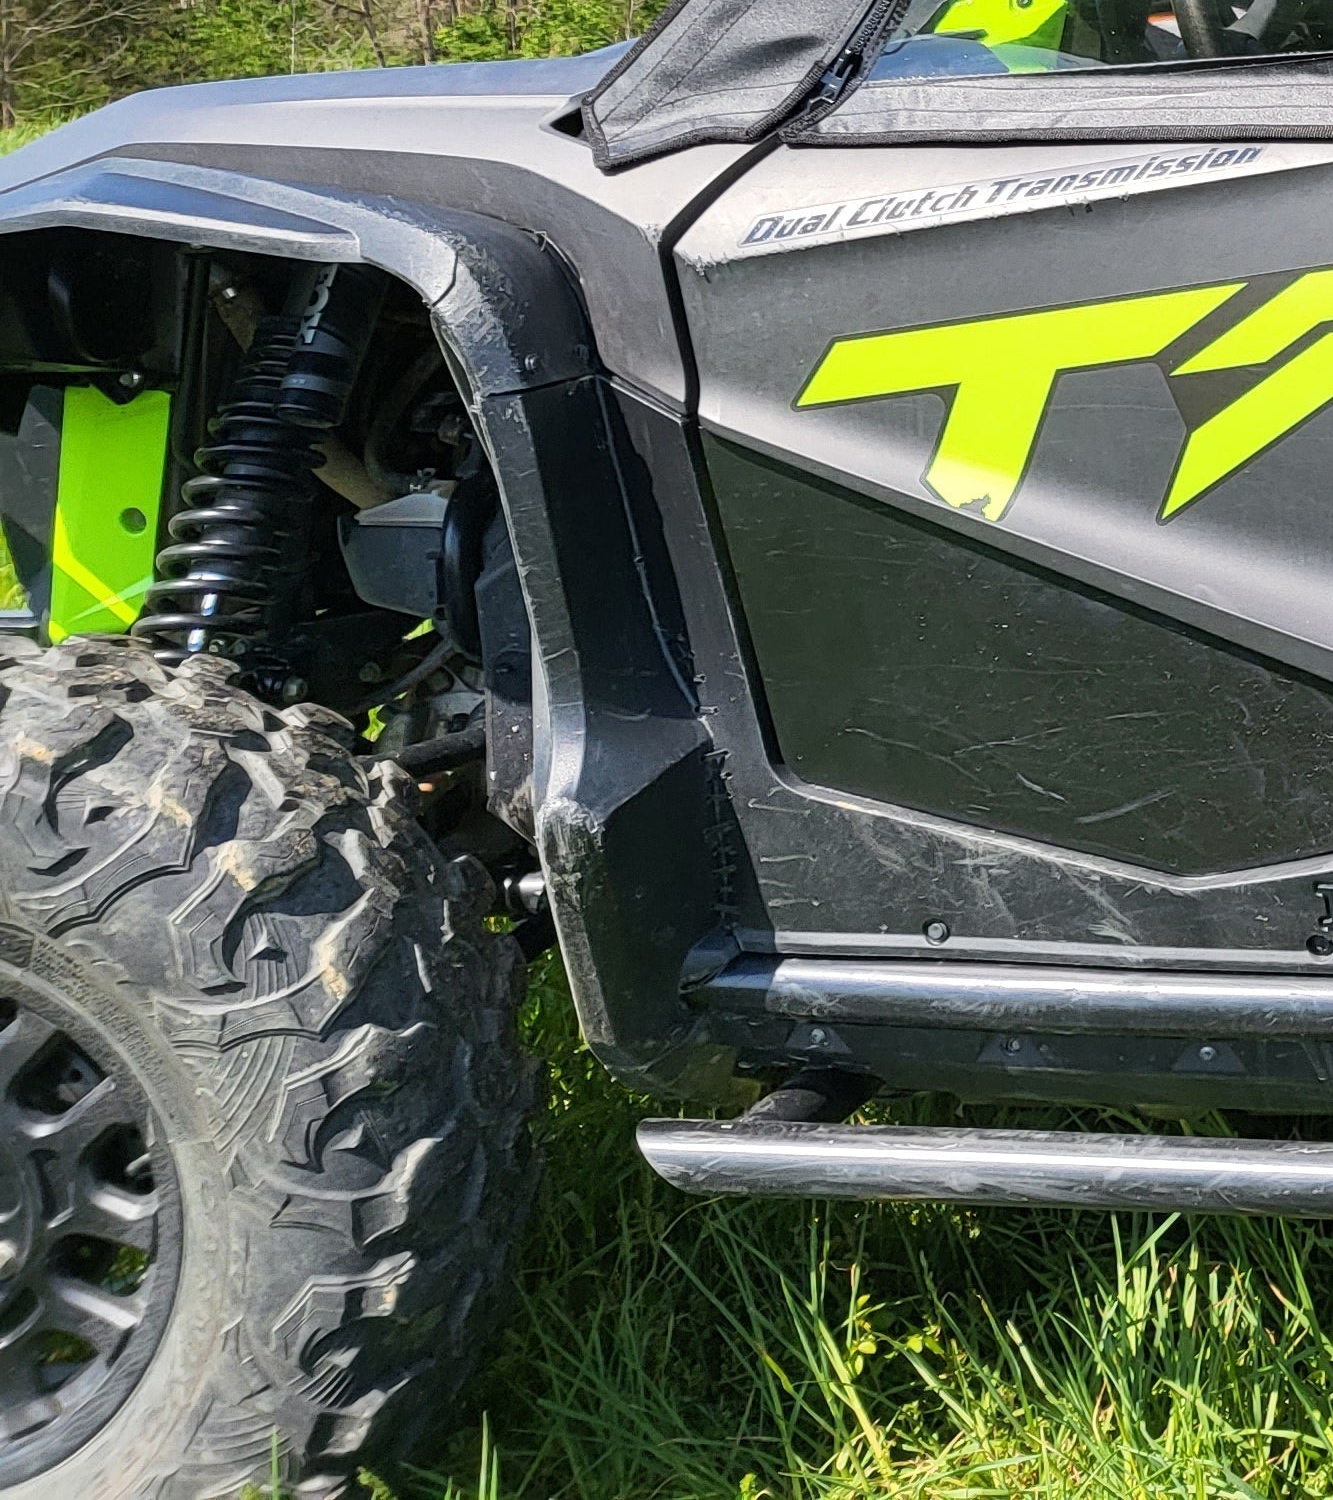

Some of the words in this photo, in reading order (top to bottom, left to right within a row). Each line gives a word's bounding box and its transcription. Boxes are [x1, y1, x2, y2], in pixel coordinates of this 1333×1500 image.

[745, 206, 844, 245] Dual
[847, 188, 976, 227] Clutch
[985, 145, 1265, 204] Transmission
